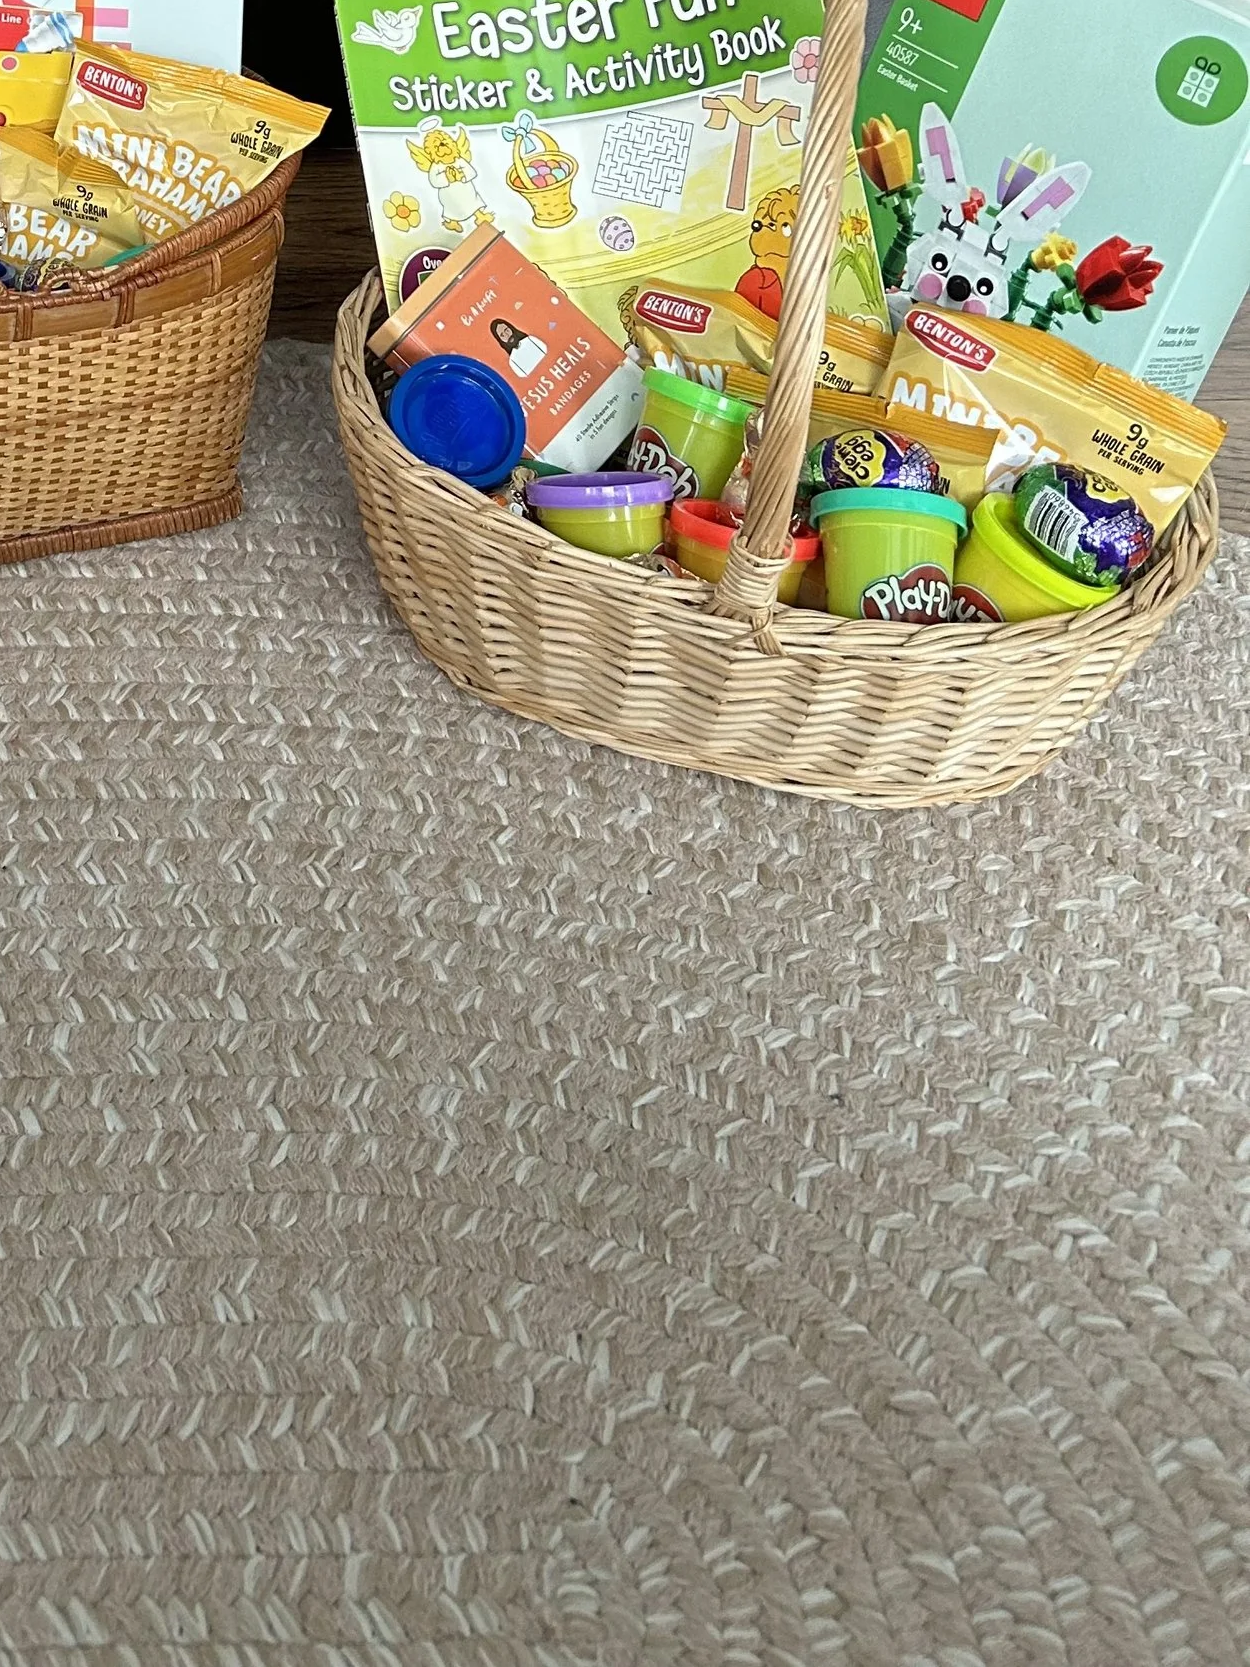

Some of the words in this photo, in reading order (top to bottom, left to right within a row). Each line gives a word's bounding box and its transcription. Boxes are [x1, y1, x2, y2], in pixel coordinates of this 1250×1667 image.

[1, 12, 23, 25] Line
[898, 6, 923, 35] 9+
[389, 73, 513, 113] Sticker
[525, 68, 553, 103] &
[565, 42, 705, 100] Activity
[710, 15, 787, 67] Book
[885, 41, 920, 67] 40587
[83, 65, 143, 103] BENTON'S
[254, 119, 272, 140] 9g
[230, 131, 259, 152] WHOLE
[260, 140, 285, 160] GRAIN
[74, 124, 168, 174] MINI
[172, 145, 243, 209] BEAR
[111, 158, 217, 223] RAHAM
[52, 197, 79, 213] WHOLE
[82, 201, 108, 219] GRAIN
[134, 205, 173, 235] NEY
[8, 202, 98, 258] BEAR
[644, 294, 705, 323] BENTON'S
[912, 314, 988, 363] BENTON'S
[549, 336, 591, 381] HEALS
[654, 350, 730, 393] MIN
[818, 350, 837, 372] 9g
[549, 370, 592, 416] BANDAGES
[823, 371, 854, 392] GRAIN
[845, 435, 875, 463] egg
[1091, 428, 1130, 456] WHOLE
[1129, 448, 1166, 475] GRAIN
[1126, 423, 1150, 451] 9g
[1097, 448, 1113, 461] PER
[1113, 455, 1145, 476] SERVING
[863, 574, 951, 621] Play-D
